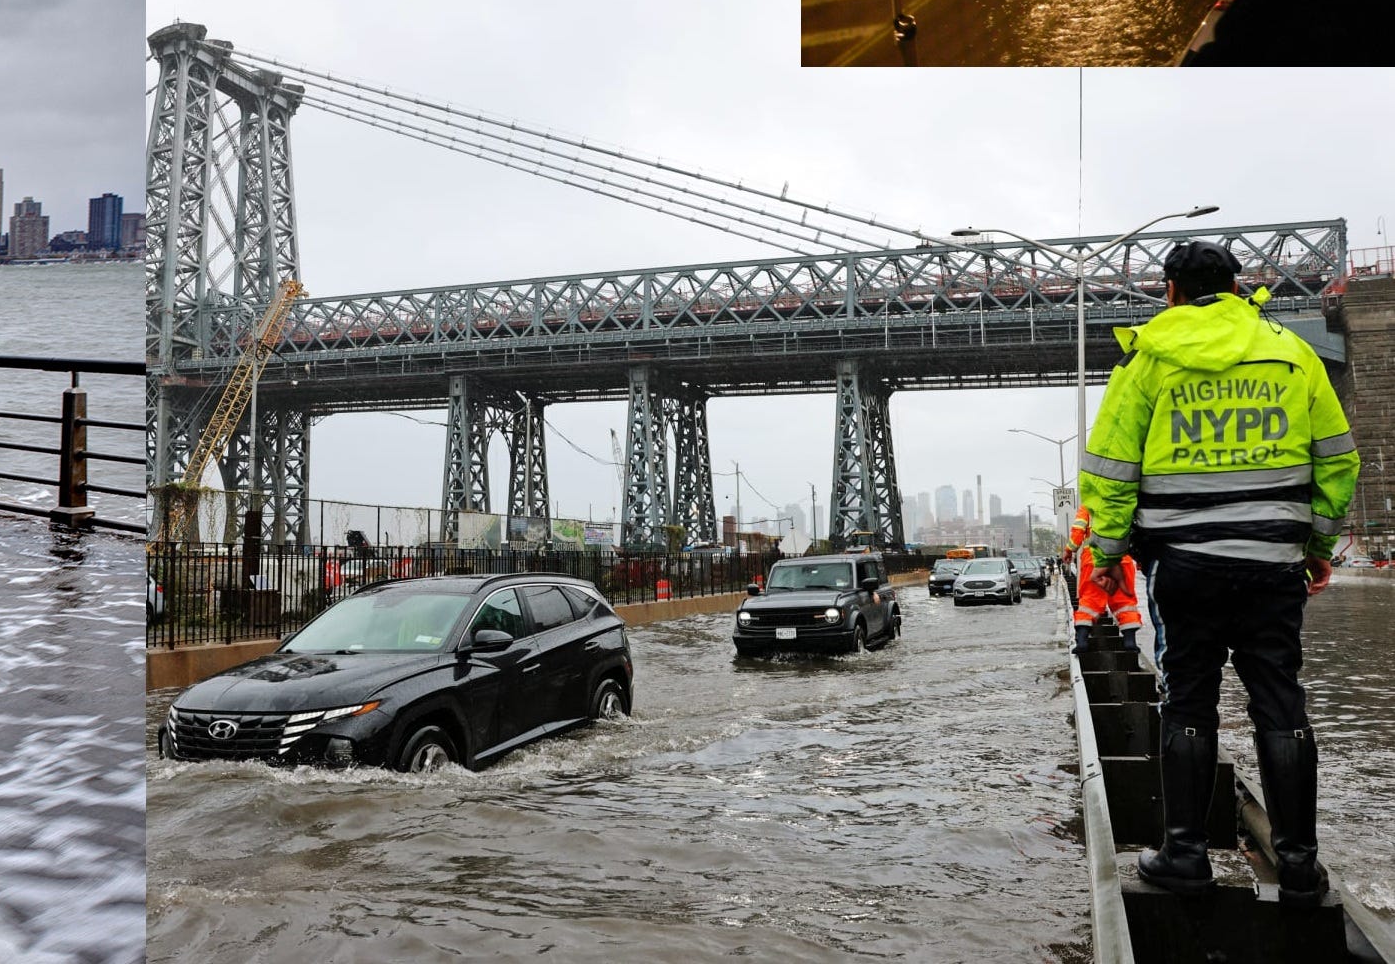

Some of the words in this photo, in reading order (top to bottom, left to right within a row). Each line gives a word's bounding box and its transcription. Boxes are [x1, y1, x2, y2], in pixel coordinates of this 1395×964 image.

[1170, 378, 1288, 407] HIGHWAY
[1171, 406, 1289, 444] NYPD
[1171, 443, 1286, 467] PATROL
